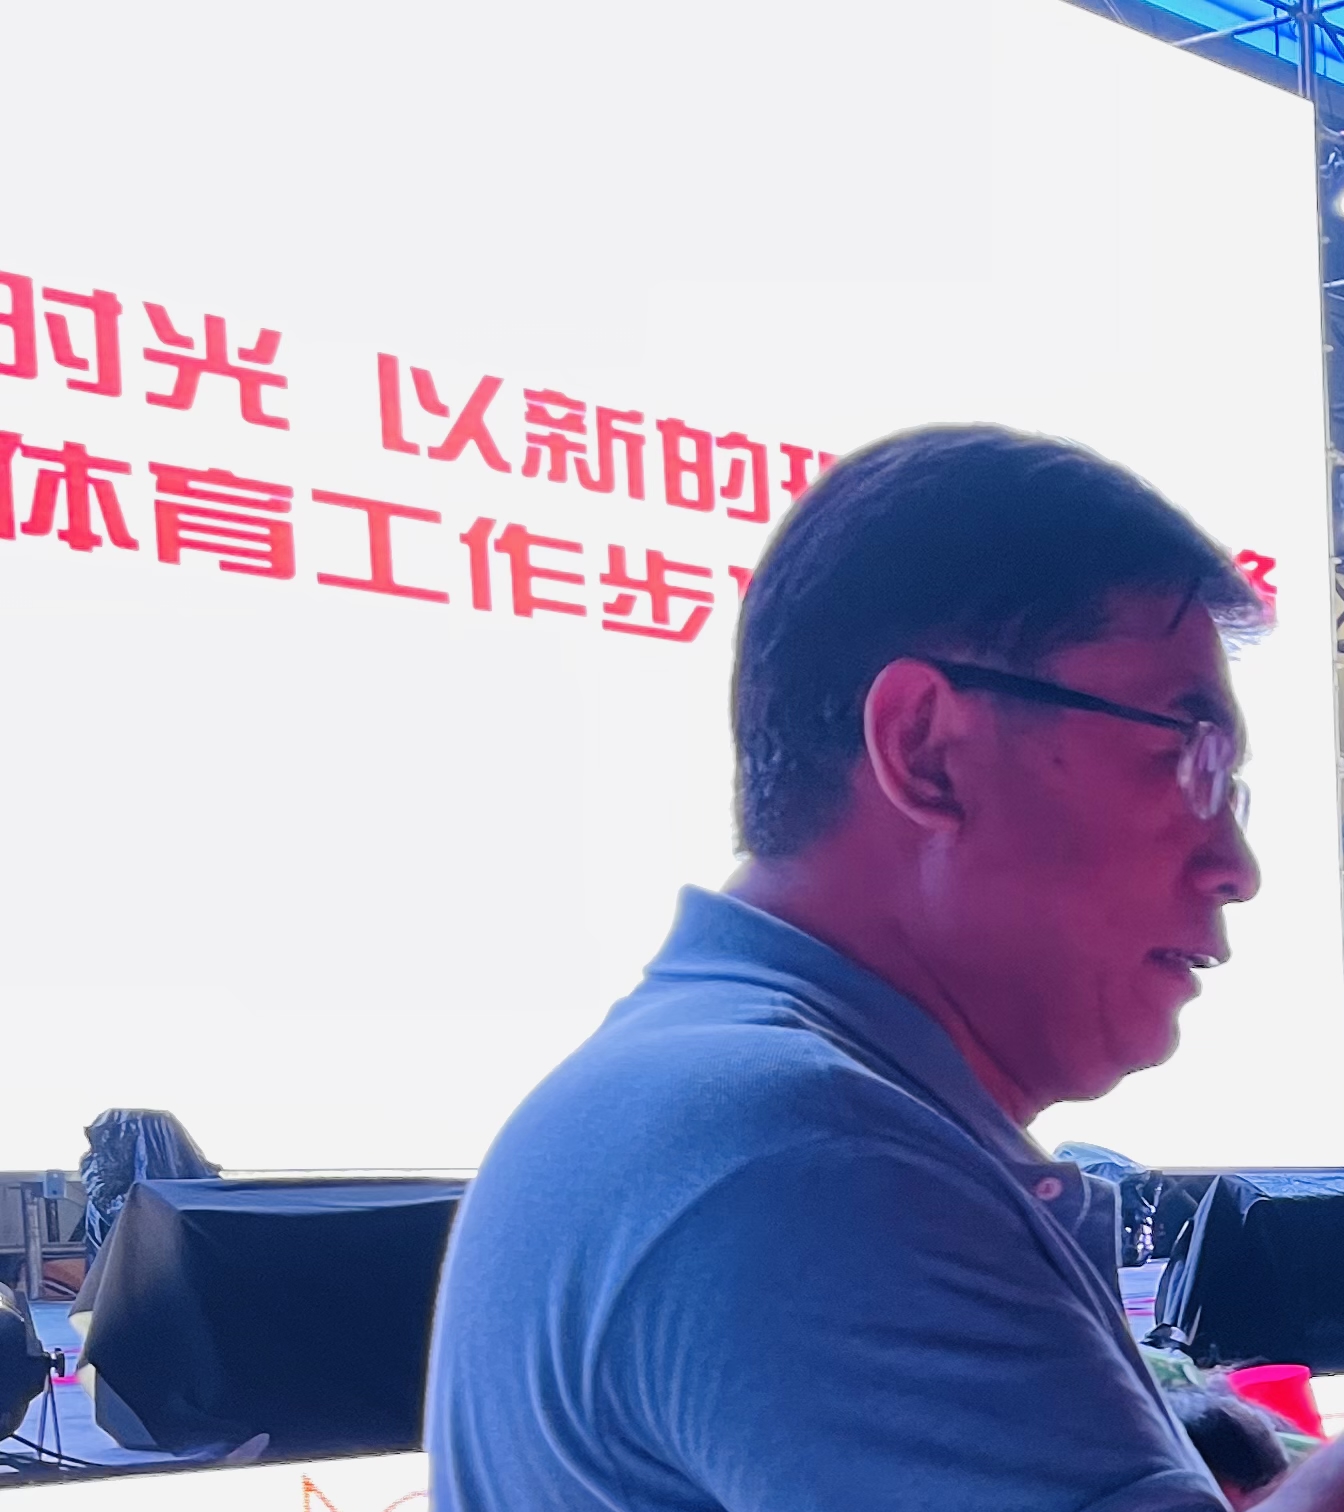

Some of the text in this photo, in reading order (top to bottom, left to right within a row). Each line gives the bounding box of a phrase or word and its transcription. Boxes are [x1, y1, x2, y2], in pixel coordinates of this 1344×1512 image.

[0, 270, 290, 431] 时光
[0, 430, 756, 643] 体育工作步
